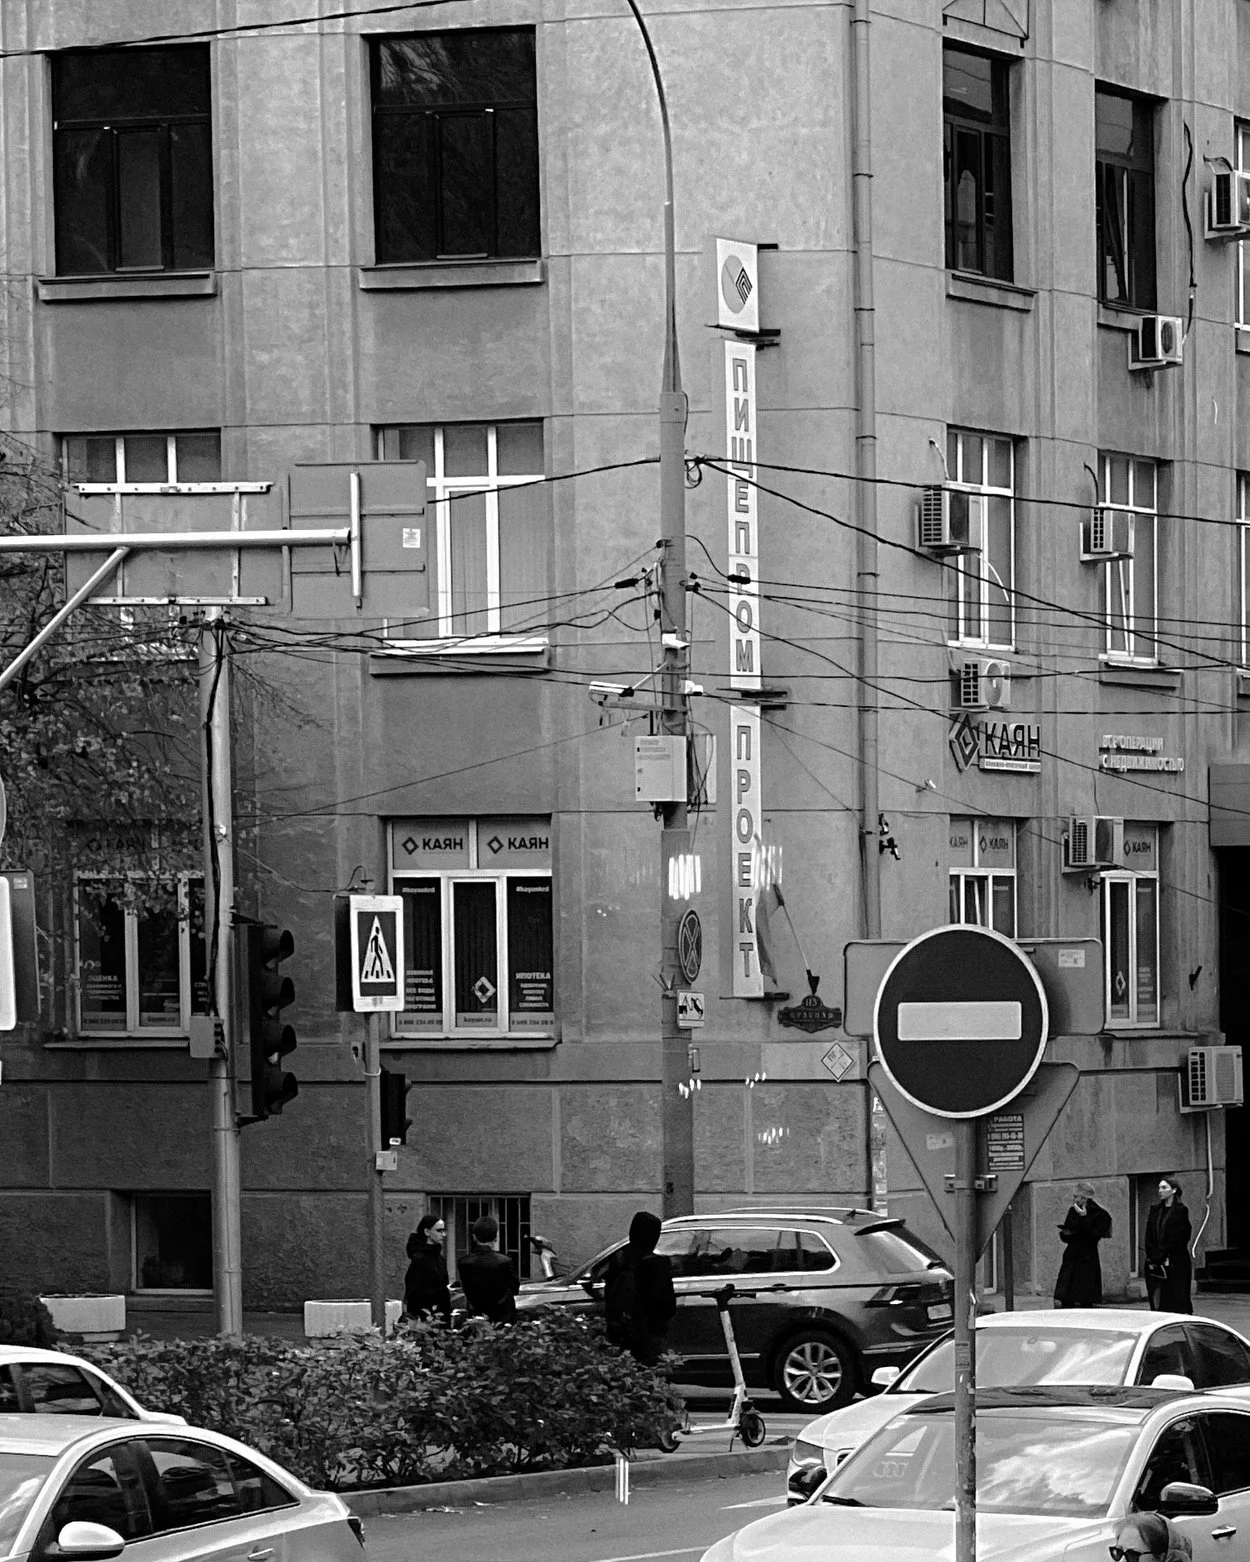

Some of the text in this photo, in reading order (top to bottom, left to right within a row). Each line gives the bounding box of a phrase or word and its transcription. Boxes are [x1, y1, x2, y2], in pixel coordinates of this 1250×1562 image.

[731, 357, 754, 674] ПИЩЕПРОМ
[984, 721, 1041, 758] КАЯН
[1121, 735, 1164, 754] ОПЕРАЦИИ
[422, 837, 464, 851] КАЯН
[508, 837, 549, 850] КАЯН
[736, 724, 754, 978] ПРОЕКТ
[1132, 841, 1152, 854] КАЯН
